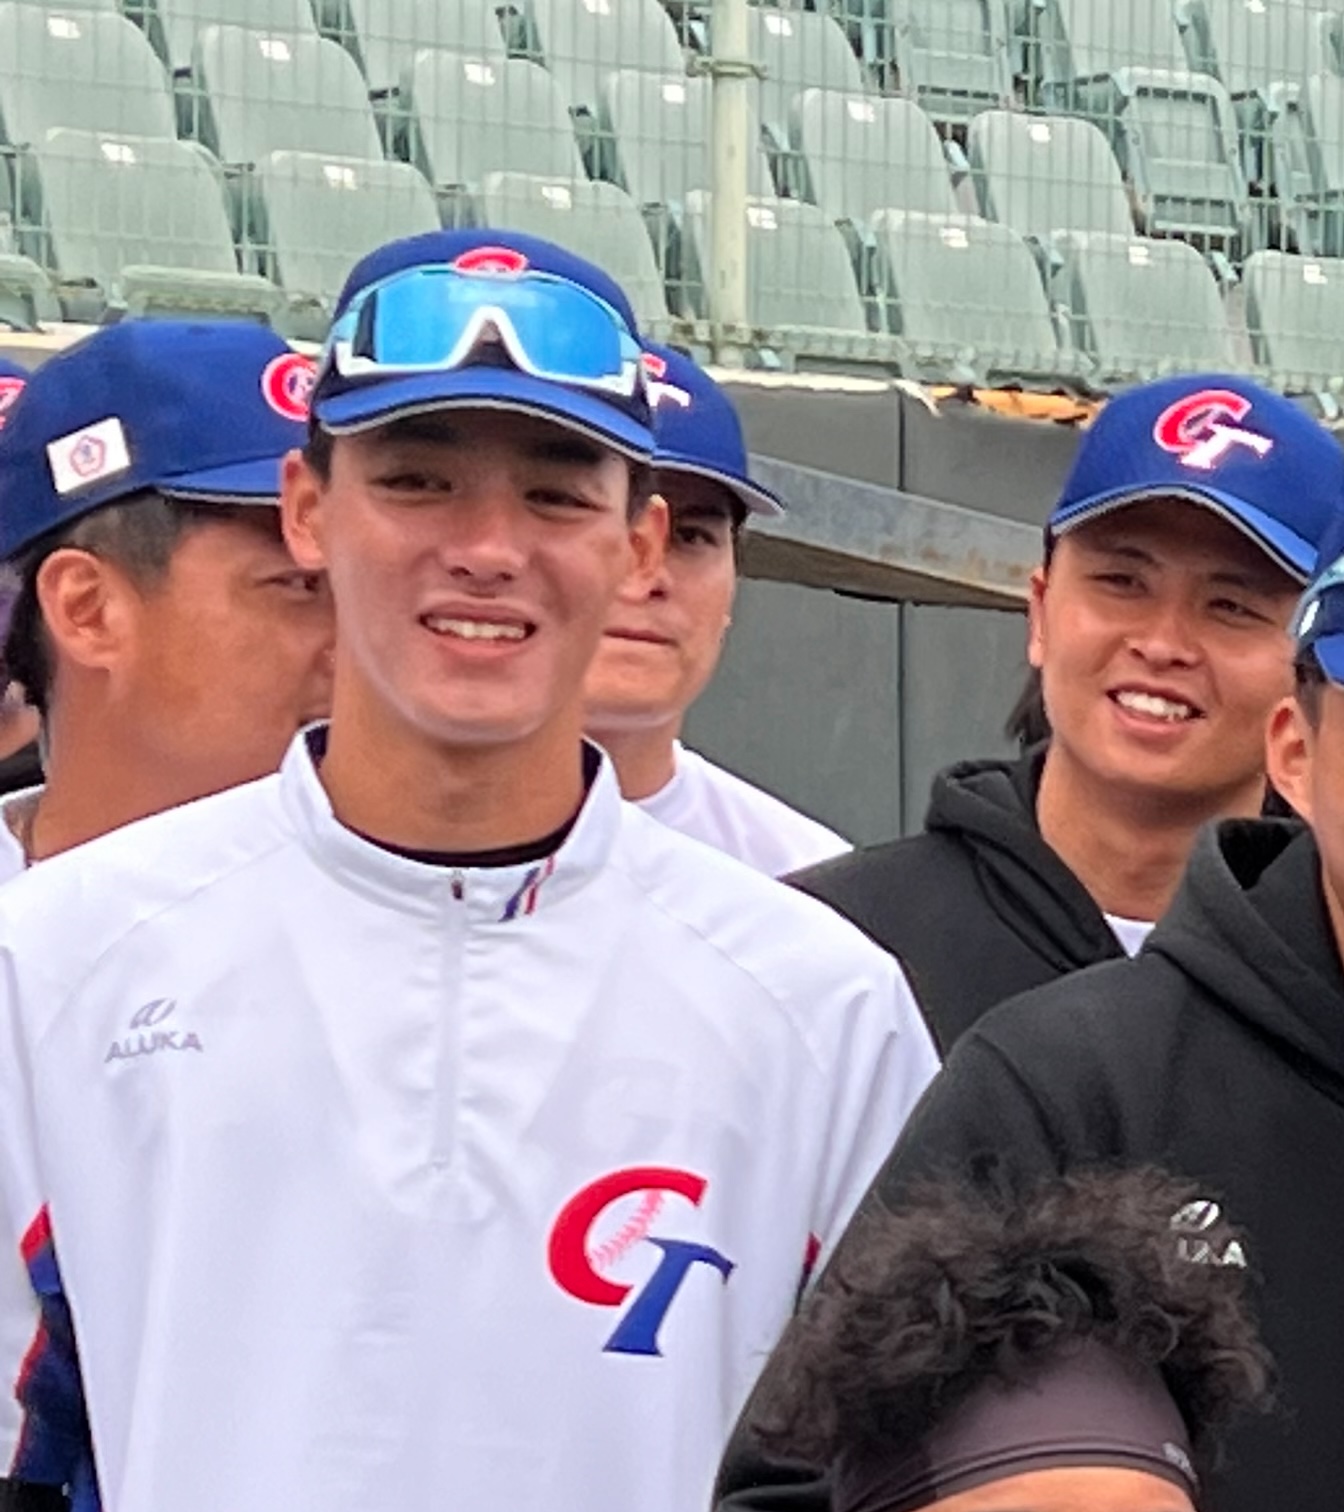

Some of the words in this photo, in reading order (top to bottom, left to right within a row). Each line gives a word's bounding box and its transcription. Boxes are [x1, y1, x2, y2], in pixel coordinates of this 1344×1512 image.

[1153, 389, 1273, 469] CT
[103, 1030, 204, 1064] ALUKA
[547, 1165, 737, 1356] CT
